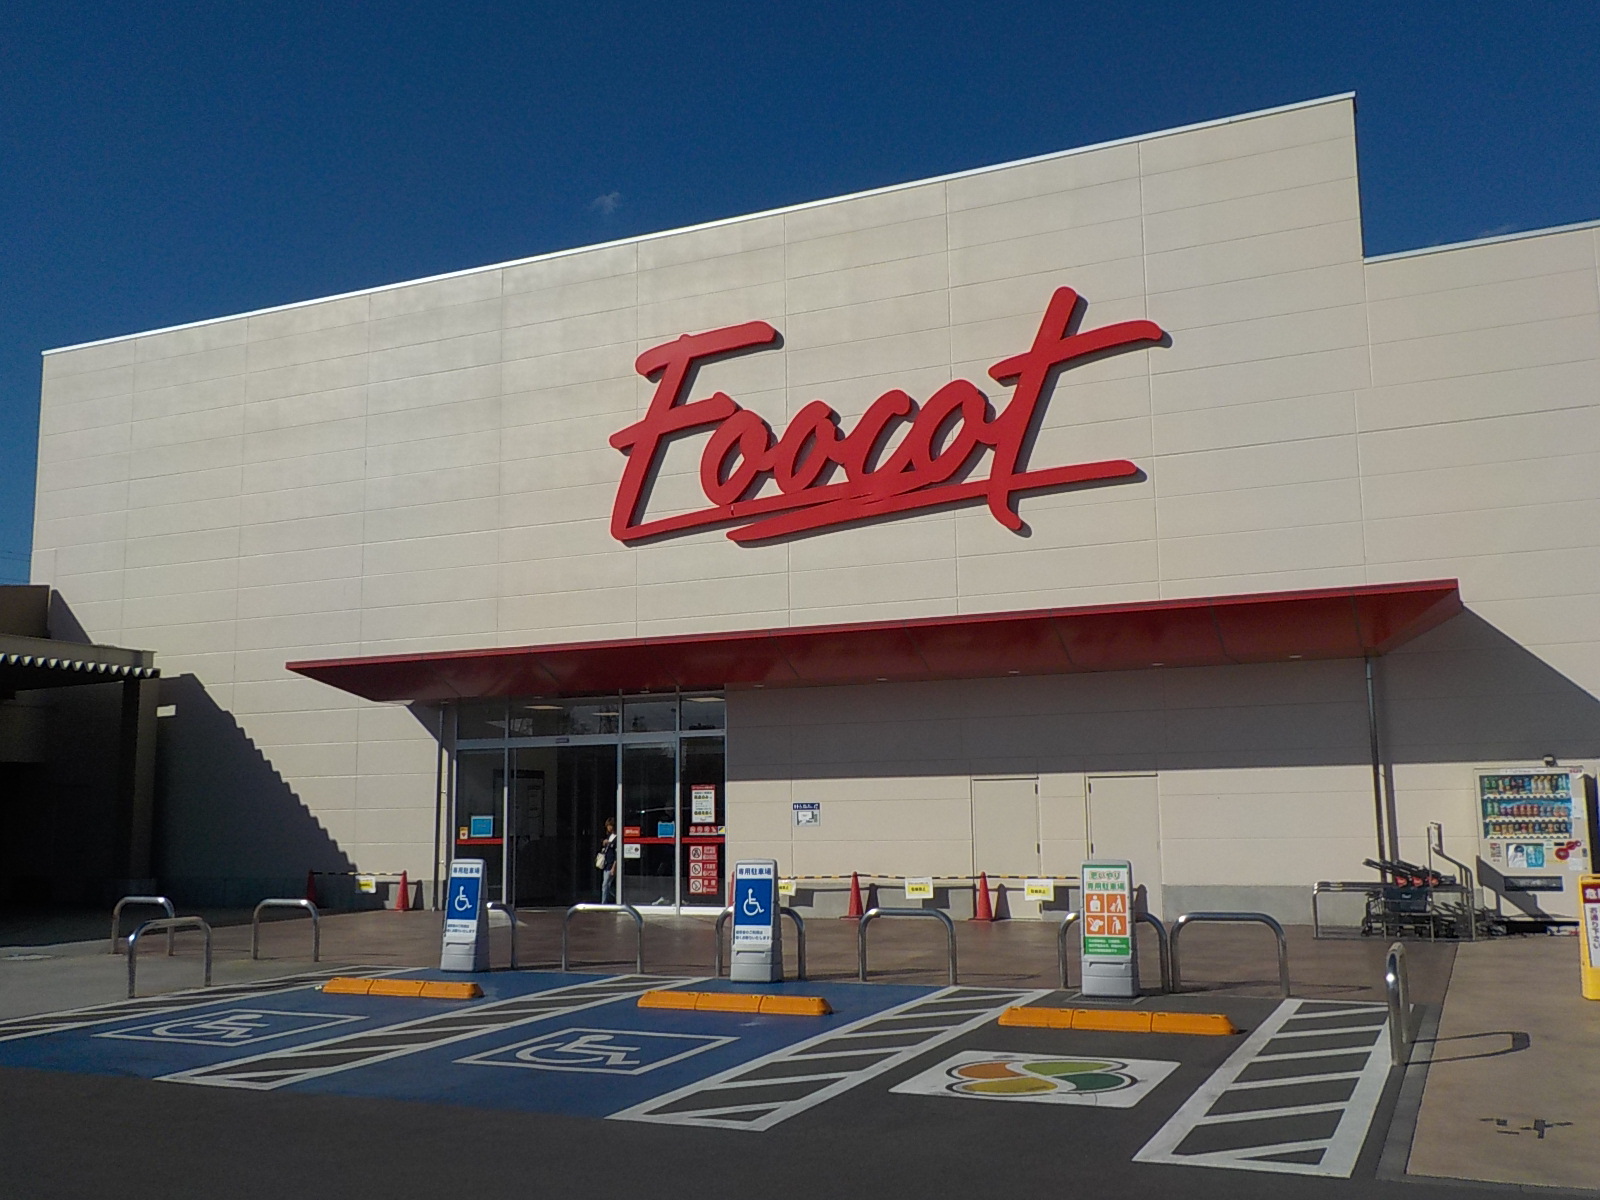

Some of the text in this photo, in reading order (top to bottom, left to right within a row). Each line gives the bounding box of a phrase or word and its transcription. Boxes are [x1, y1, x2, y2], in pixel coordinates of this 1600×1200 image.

[609, 286, 1163, 541] Foocot
[738, 867, 772, 875] 専用駐車場
[1089, 871, 1120, 880] 思いやり
[1087, 882, 1125, 891] 専用駐車場
[1585, 887, 1600, 900] 危
